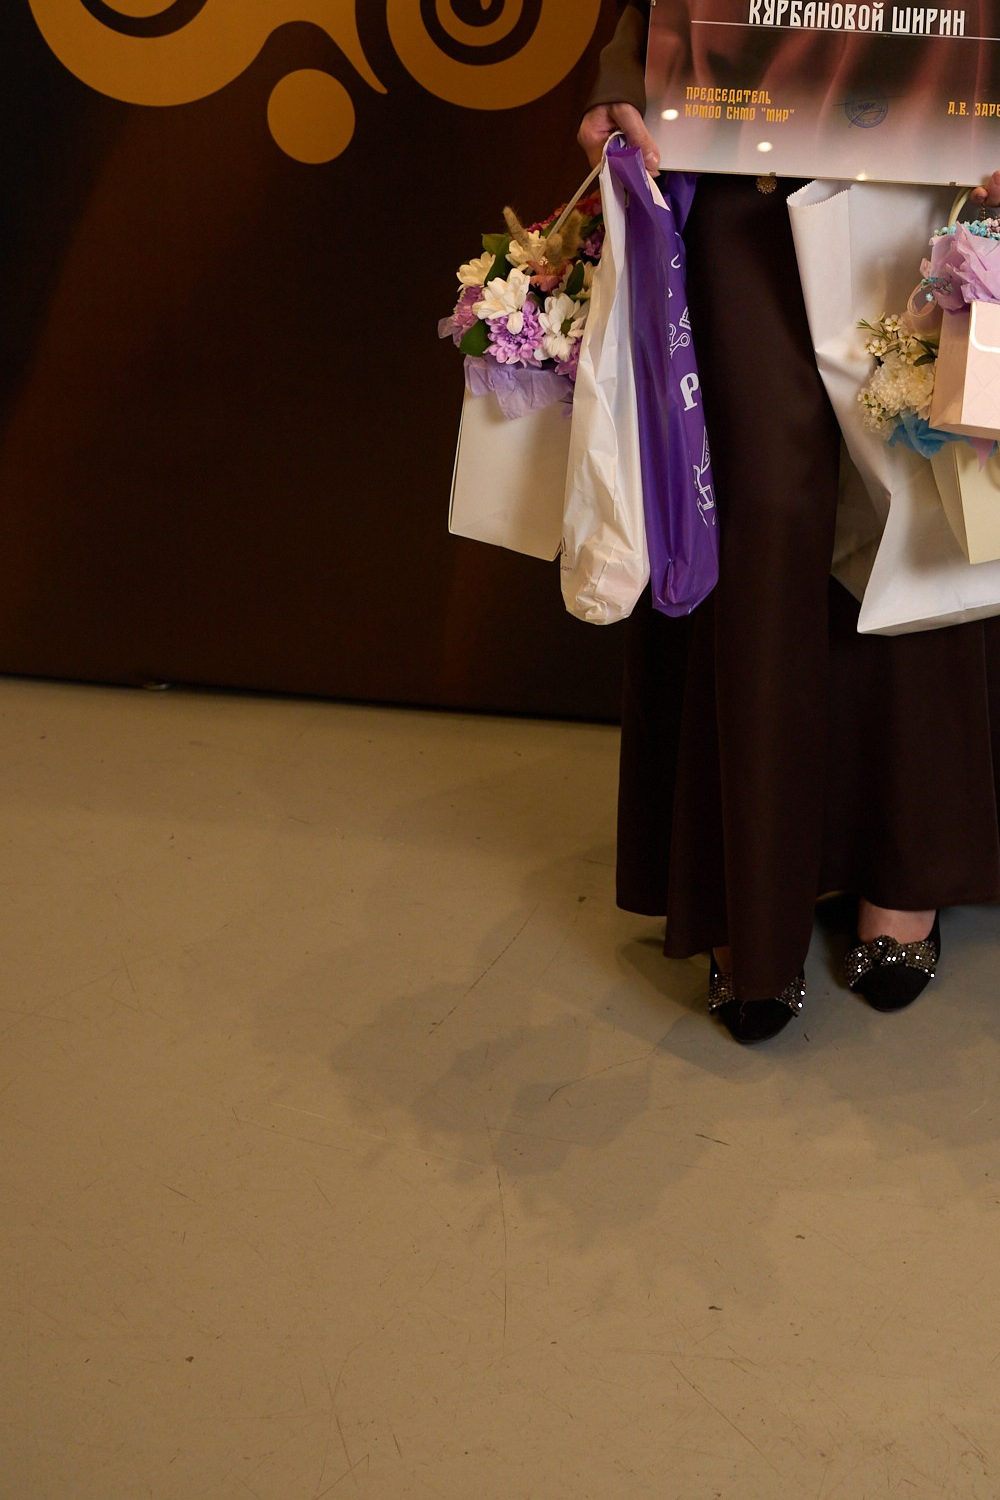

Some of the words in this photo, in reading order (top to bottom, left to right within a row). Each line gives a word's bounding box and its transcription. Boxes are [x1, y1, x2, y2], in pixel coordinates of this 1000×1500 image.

[891, 6, 966, 36] ШИРИН
[685, 86, 771, 104] ПРЕДСЕДАТЕЛЬ
[685, 103, 722, 119] КРМОО
[761, 107, 795, 122] "МИР"
[947, 101, 970, 115] А.В.
